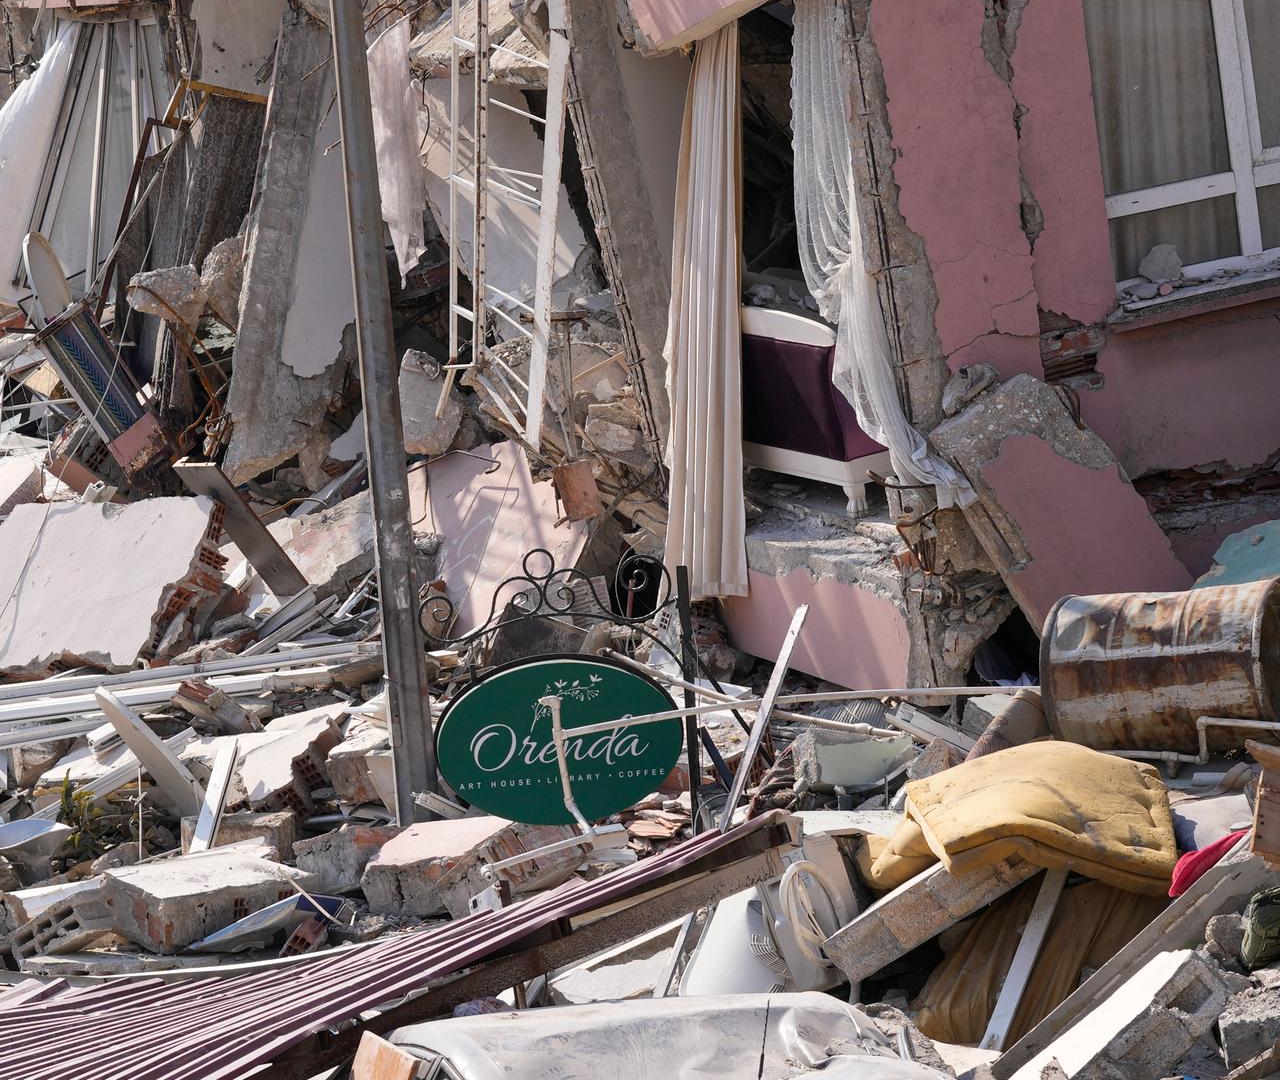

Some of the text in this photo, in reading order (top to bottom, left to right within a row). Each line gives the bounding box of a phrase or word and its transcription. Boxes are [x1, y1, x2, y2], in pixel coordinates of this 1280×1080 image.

[470, 714, 650, 771] Orenda
[459, 767, 665, 791] ART HOUSE LIRARY COFFEE
